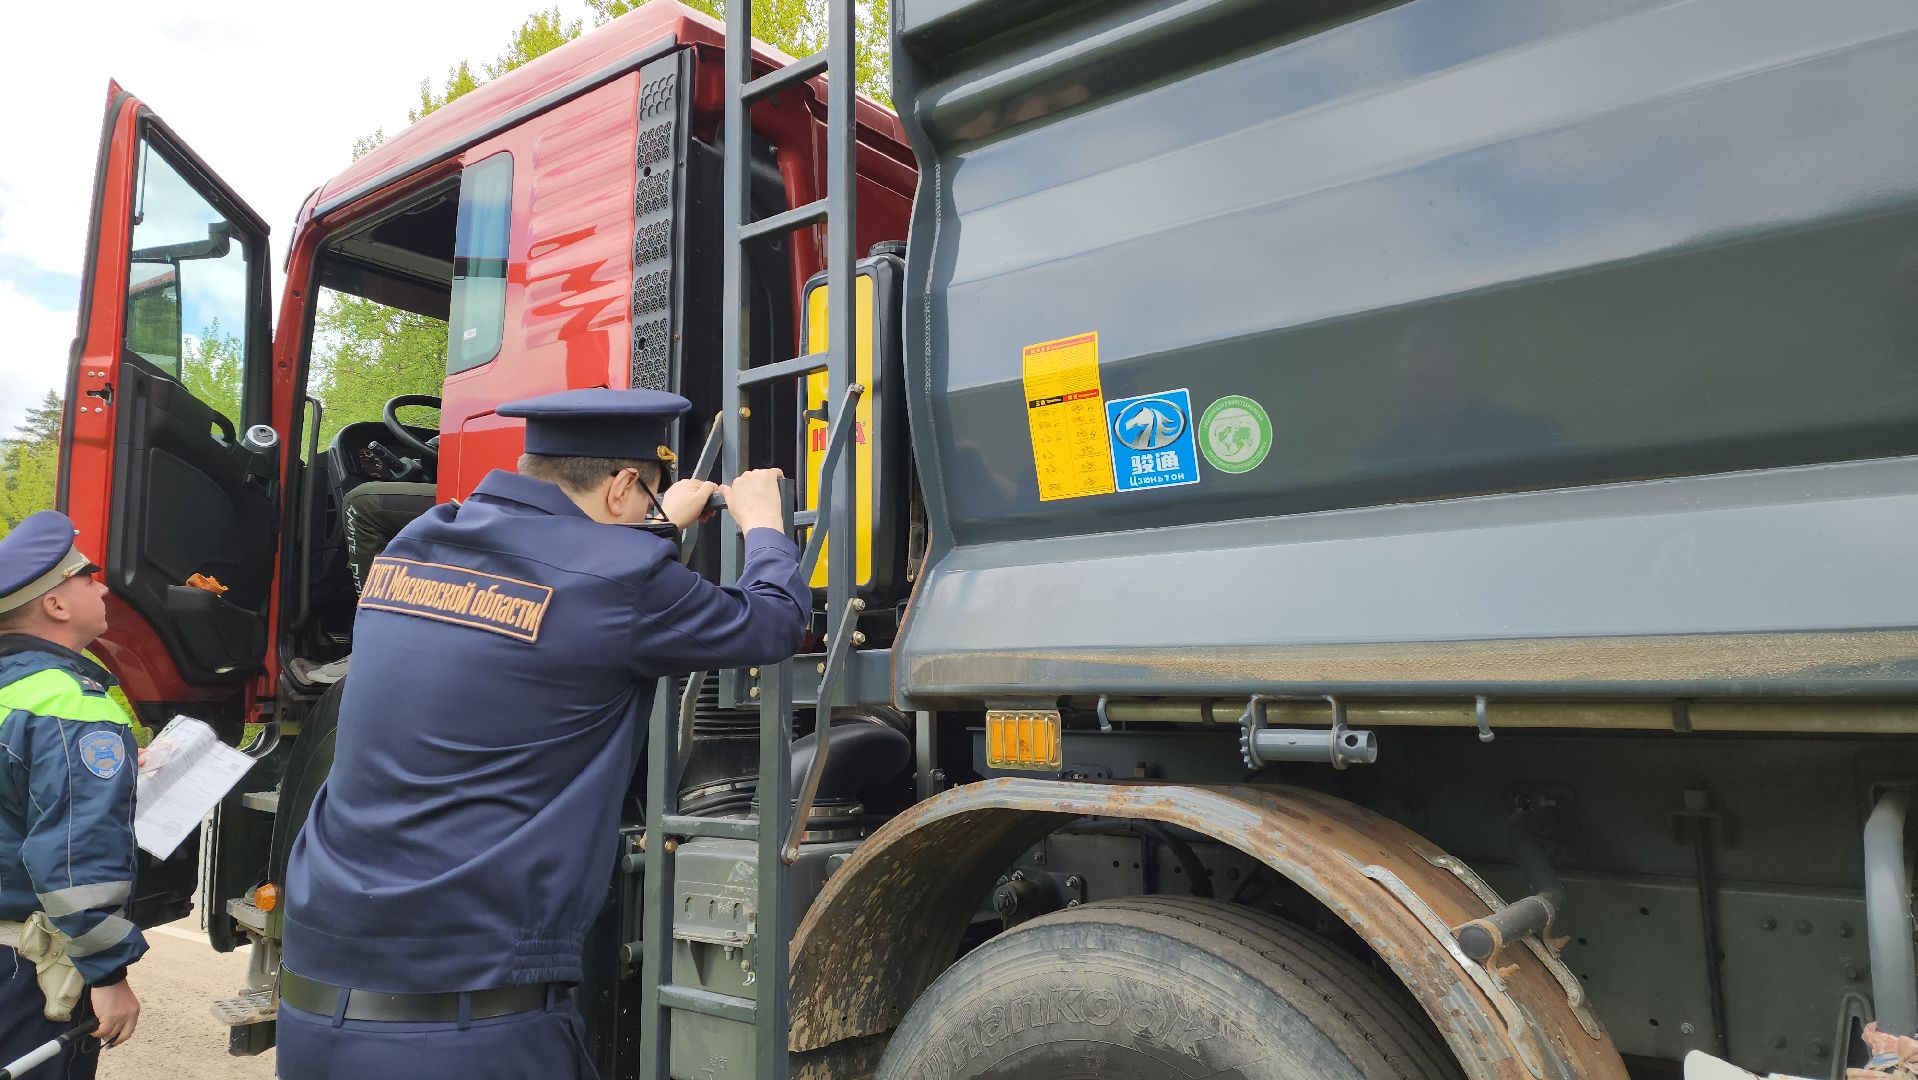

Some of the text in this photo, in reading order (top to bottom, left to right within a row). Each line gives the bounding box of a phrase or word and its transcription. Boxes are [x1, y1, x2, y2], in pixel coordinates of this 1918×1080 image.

[1131, 450, 1180, 475] 骏通
[385, 565, 478, 615] Московской
[469, 584, 543, 632] области
